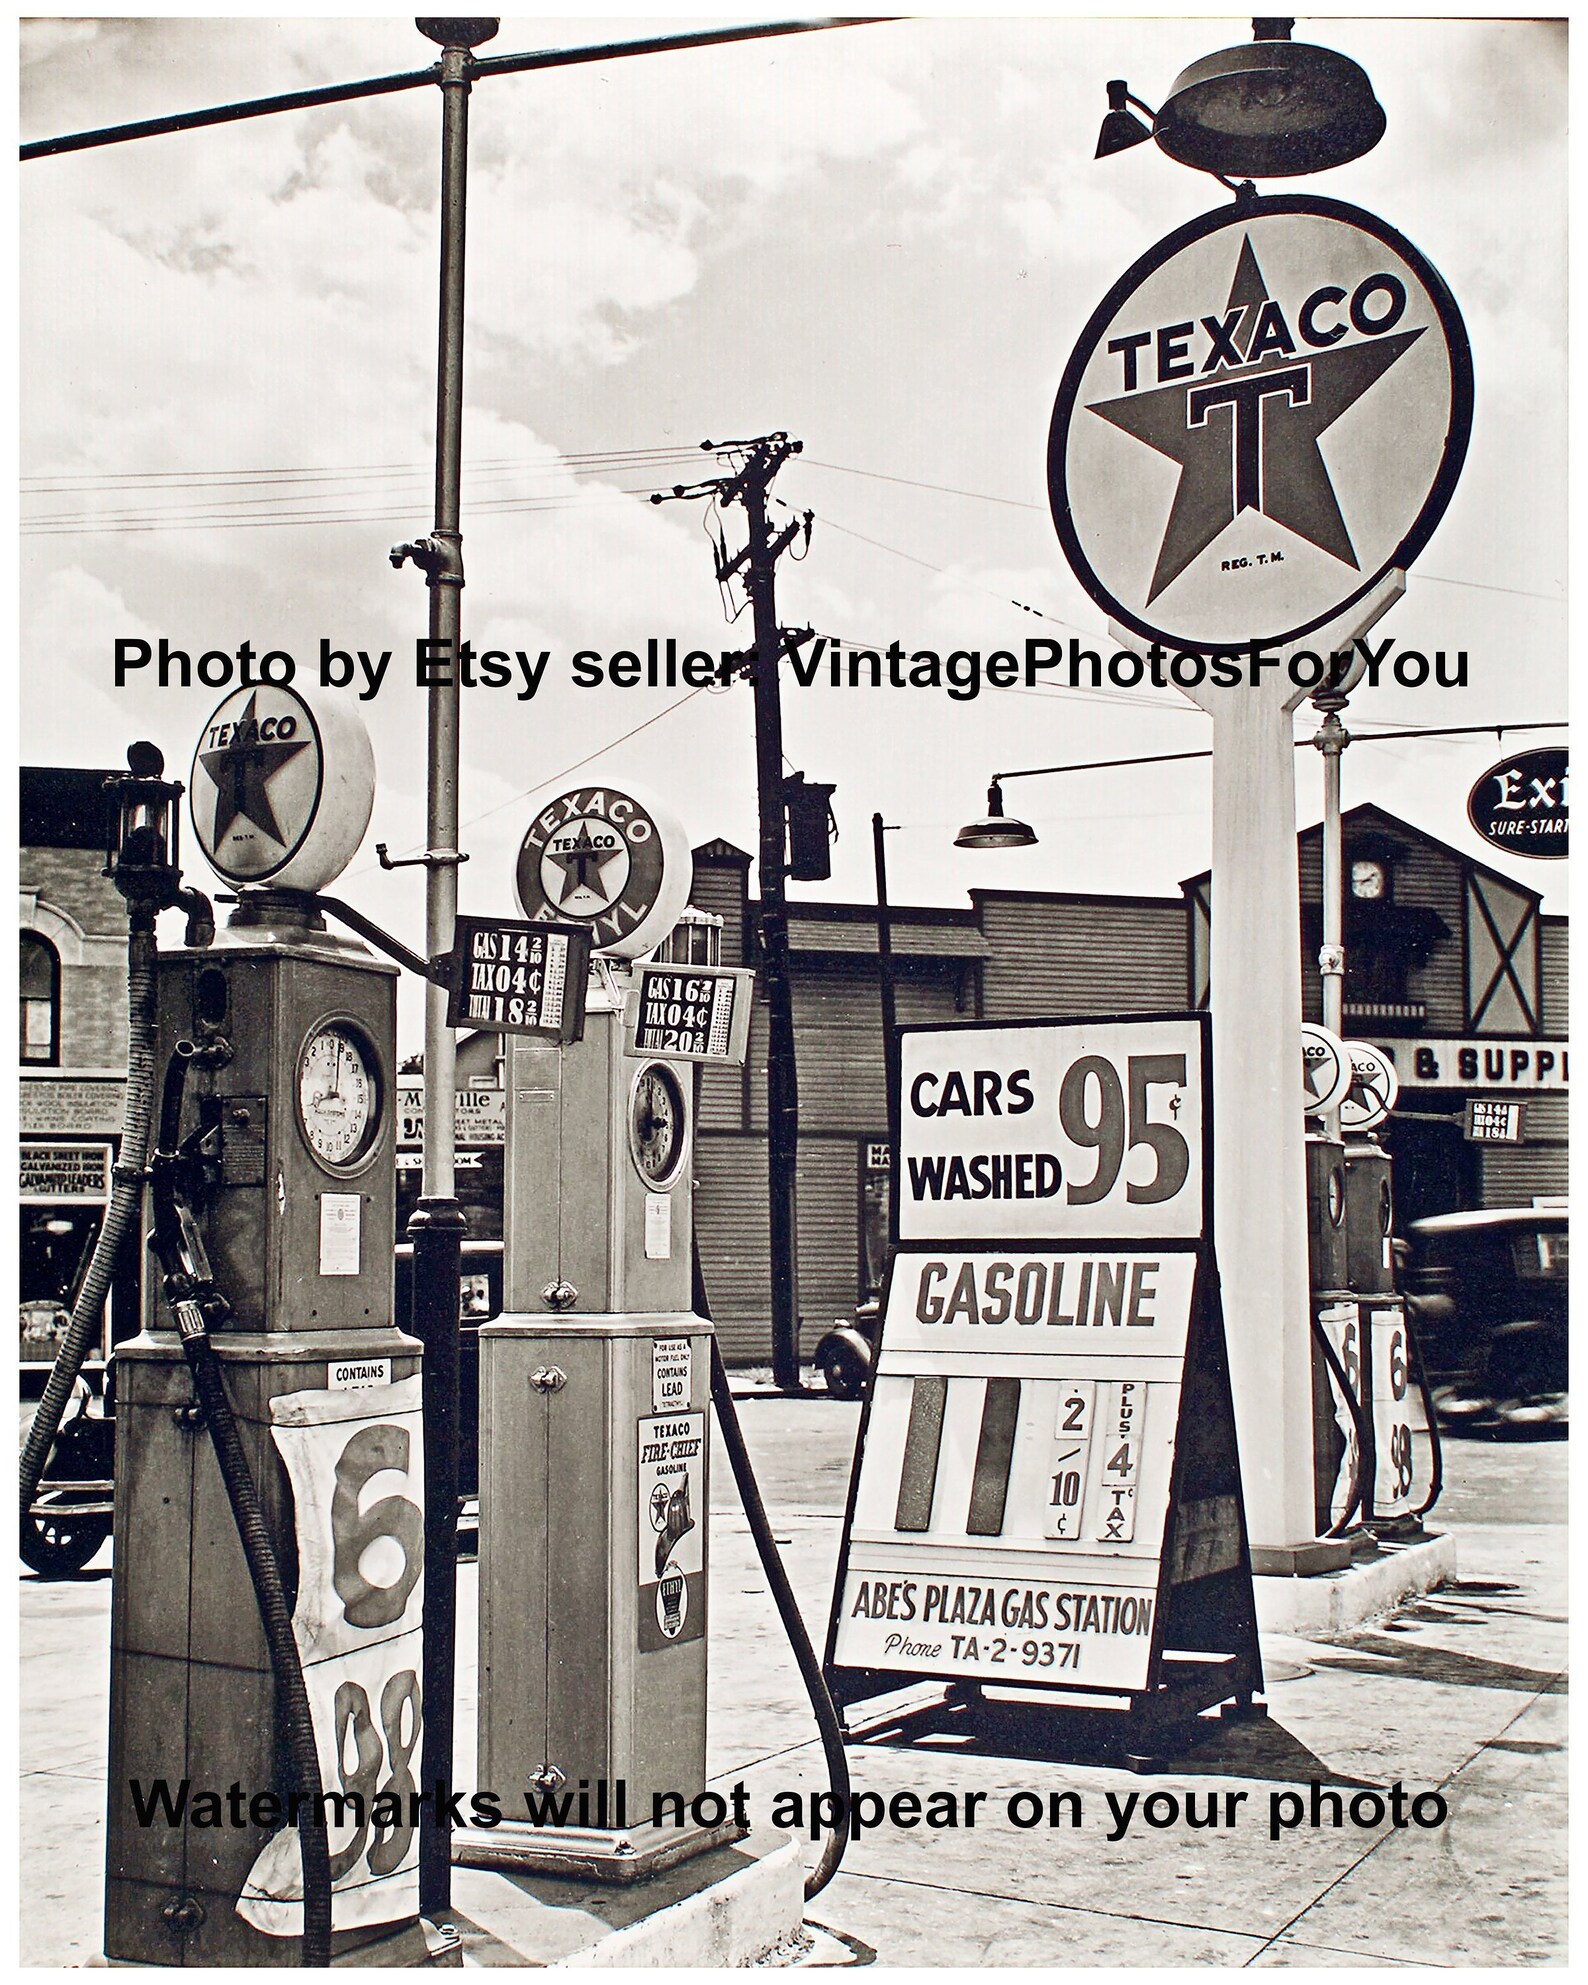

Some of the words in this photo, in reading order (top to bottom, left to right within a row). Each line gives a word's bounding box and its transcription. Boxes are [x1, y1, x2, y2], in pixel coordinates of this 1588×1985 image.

[1107, 273, 1407, 392] TEXACO
[1187, 363, 1312, 520] T
[1221, 557, 1253, 572] REG.
[209, 716, 297, 748] TEXACO
[524, 791, 652, 850] TEXACO
[553, 835, 615, 851] TEXACO
[473, 932, 498, 960] GAS
[499, 934, 528, 963] 14
[471, 962, 496, 991] TAX
[647, 976, 671, 1000] GAS
[671, 978, 699, 1002] 16
[494, 997, 525, 1025] 18
[645, 1002, 668, 1025] TAX
[664, 1029, 693, 1052] 20
[1416, 1048, 1439, 1080] &
[910, 1069, 1034, 1118] CARS
[907, 1153, 1063, 1201] WASHED
[915, 1261, 1161, 1327] GASOLINE
[336, 1365, 384, 1381] CONTAINS
[657, 1366, 688, 1379] CONTAINS
[661, 1382, 683, 1397] LEAD
[653, 1422, 690, 1438] TEXACO
[641, 1438, 702, 1464] FIRE-CHIEF
[656, 1462, 687, 1476] GASOLINE
[331, 1424, 423, 1628] 6
[851, 1580, 917, 1621] ABE'S
[923, 1585, 996, 1626] PLAZA
[1001, 1588, 1050, 1630] GAS
[1053, 1593, 1153, 1637] STATION
[884, 1633, 942, 1659] Phone
[950, 1635, 1081, 1669] TA-2-9371
